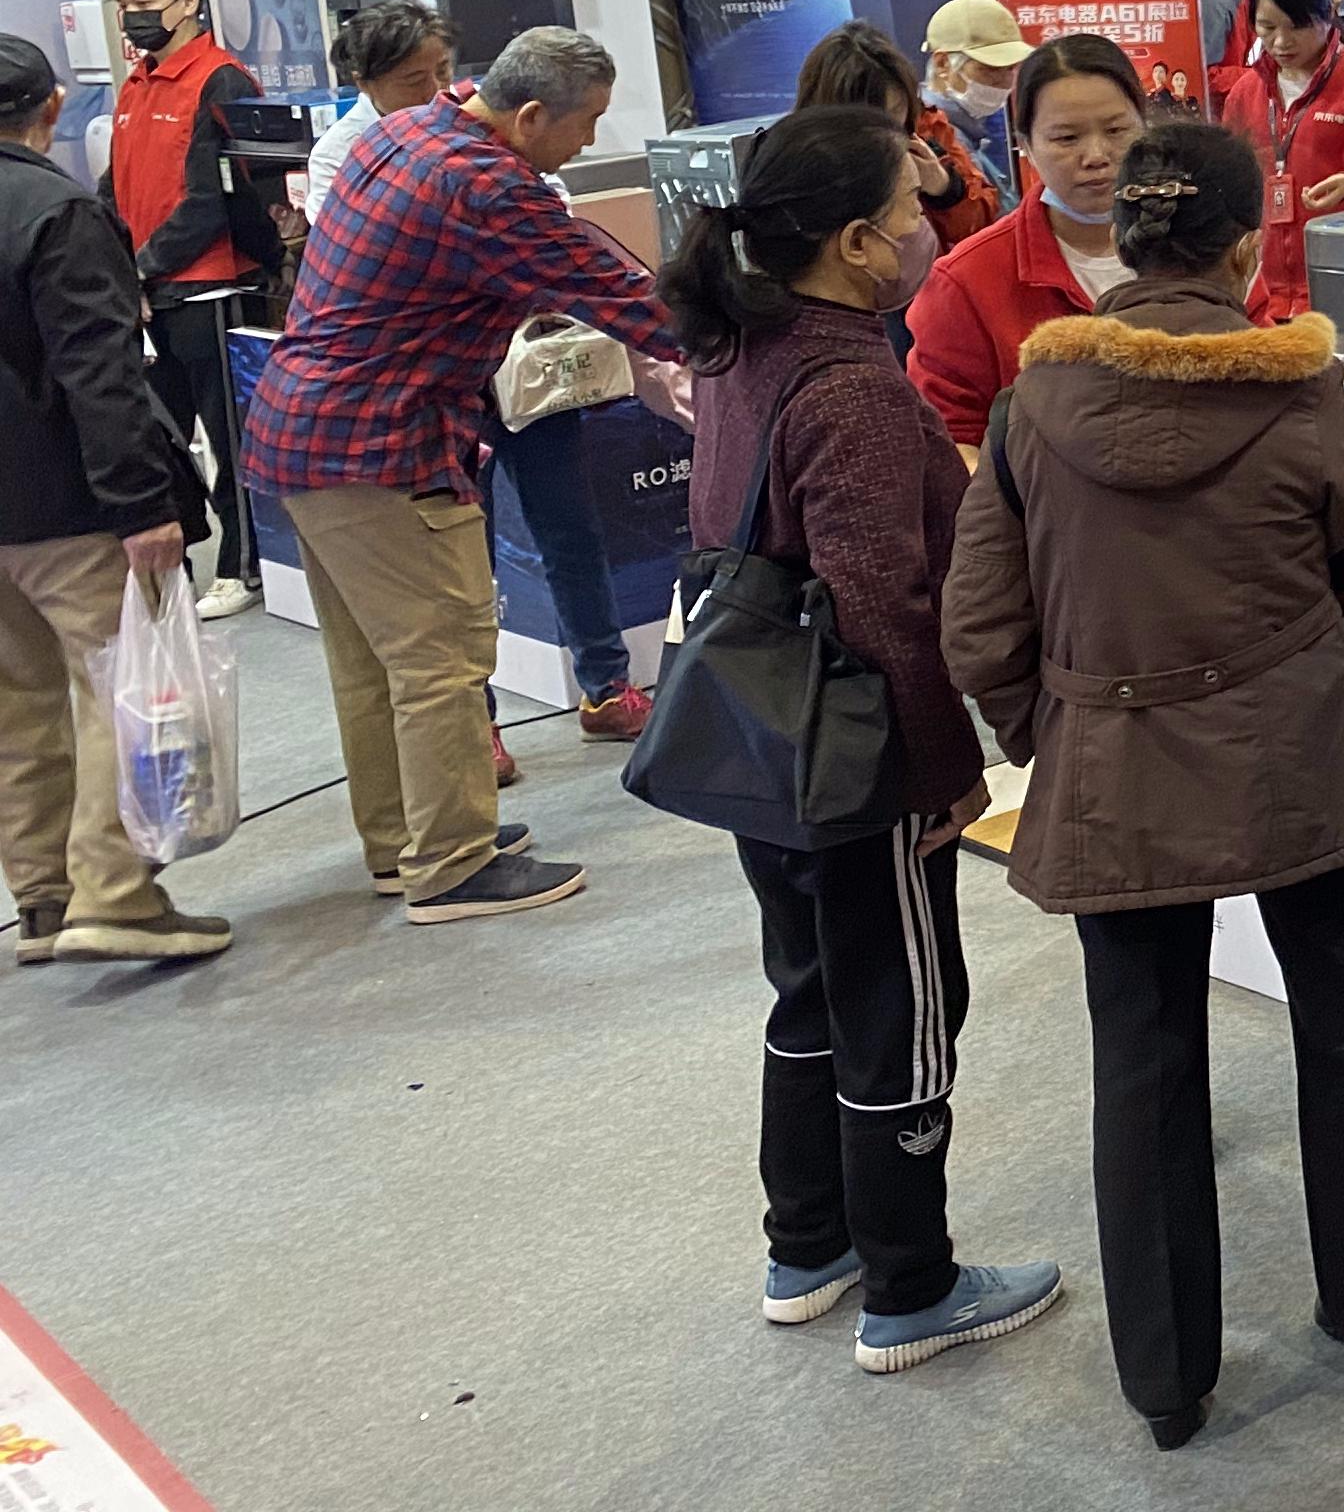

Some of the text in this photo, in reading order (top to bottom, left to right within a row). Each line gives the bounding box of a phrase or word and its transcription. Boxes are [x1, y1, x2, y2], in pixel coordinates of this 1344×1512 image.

[1016, 2, 1190, 26] 京东电器A61展位
